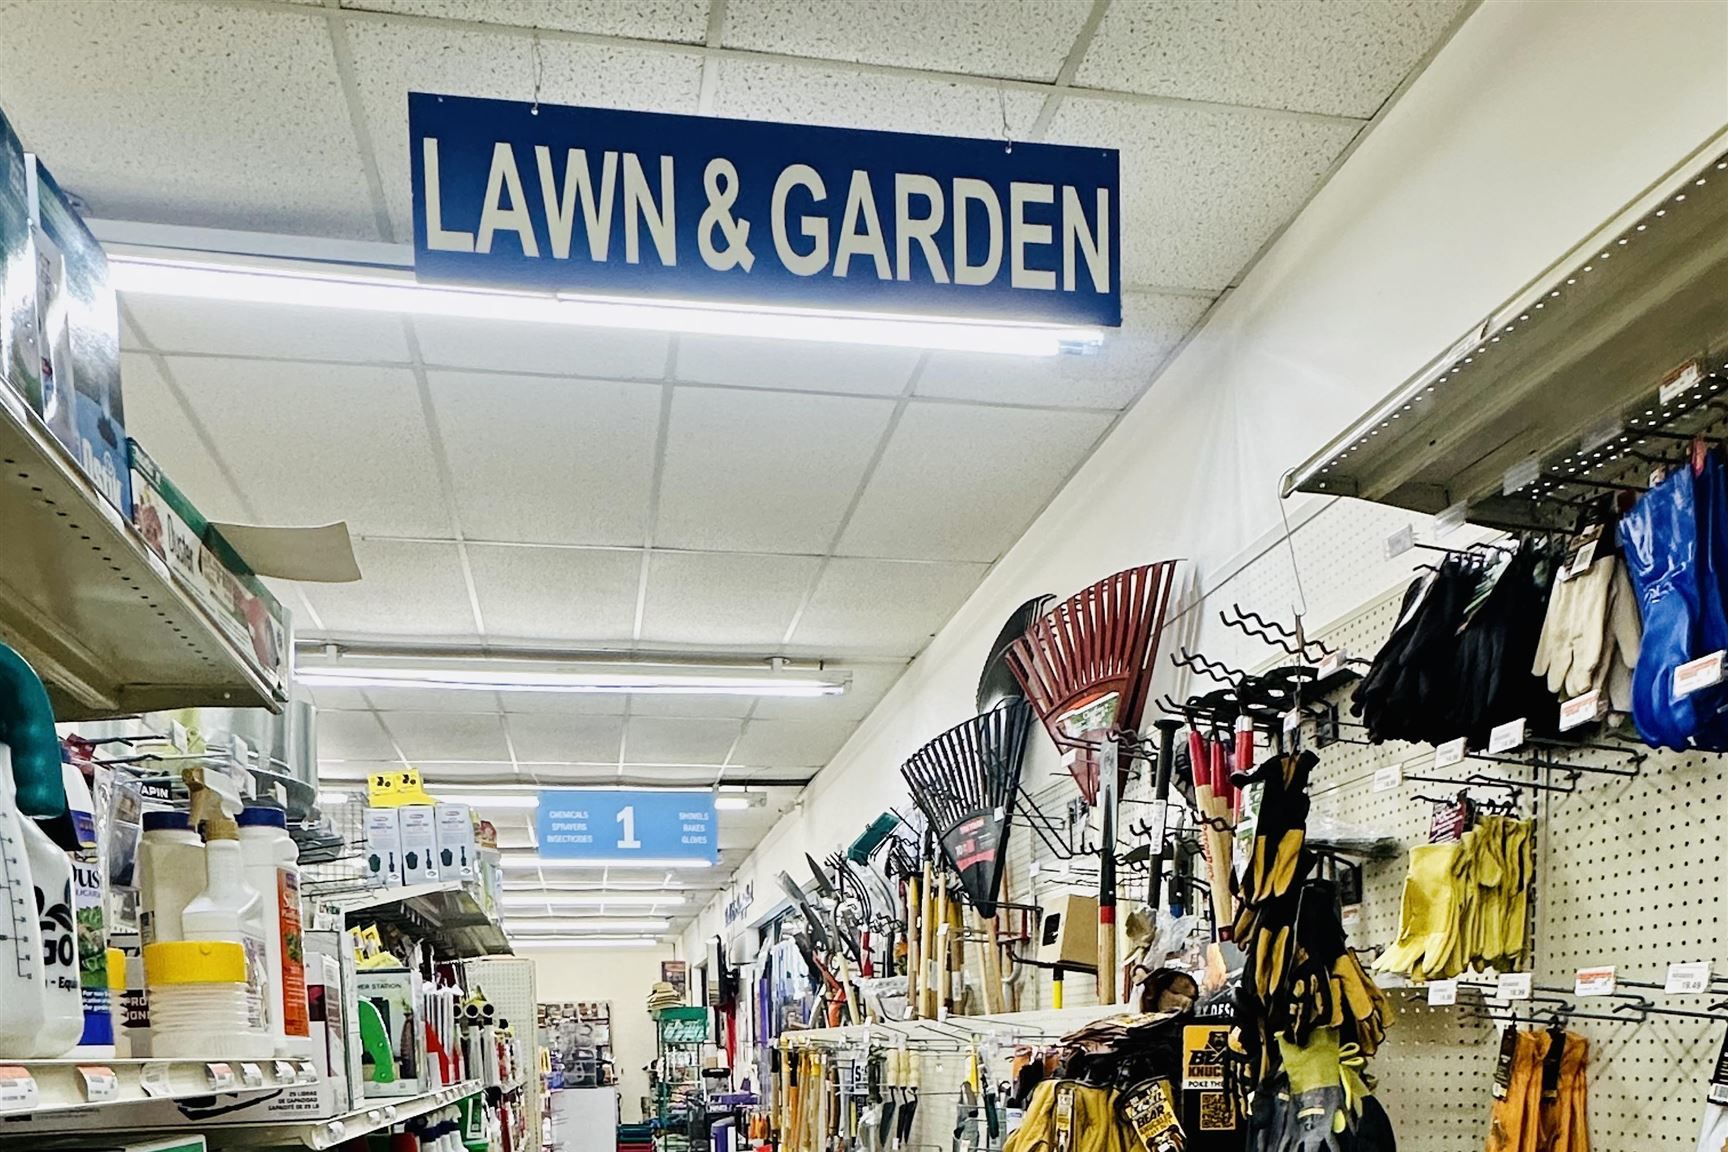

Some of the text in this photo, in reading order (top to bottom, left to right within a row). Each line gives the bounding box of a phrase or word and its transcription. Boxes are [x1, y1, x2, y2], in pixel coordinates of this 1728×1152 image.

[423, 137, 1110, 293] LAWN & GARDEN
[616, 806, 641, 848] 1
[1188, 1066, 1223, 1077] KNUC
